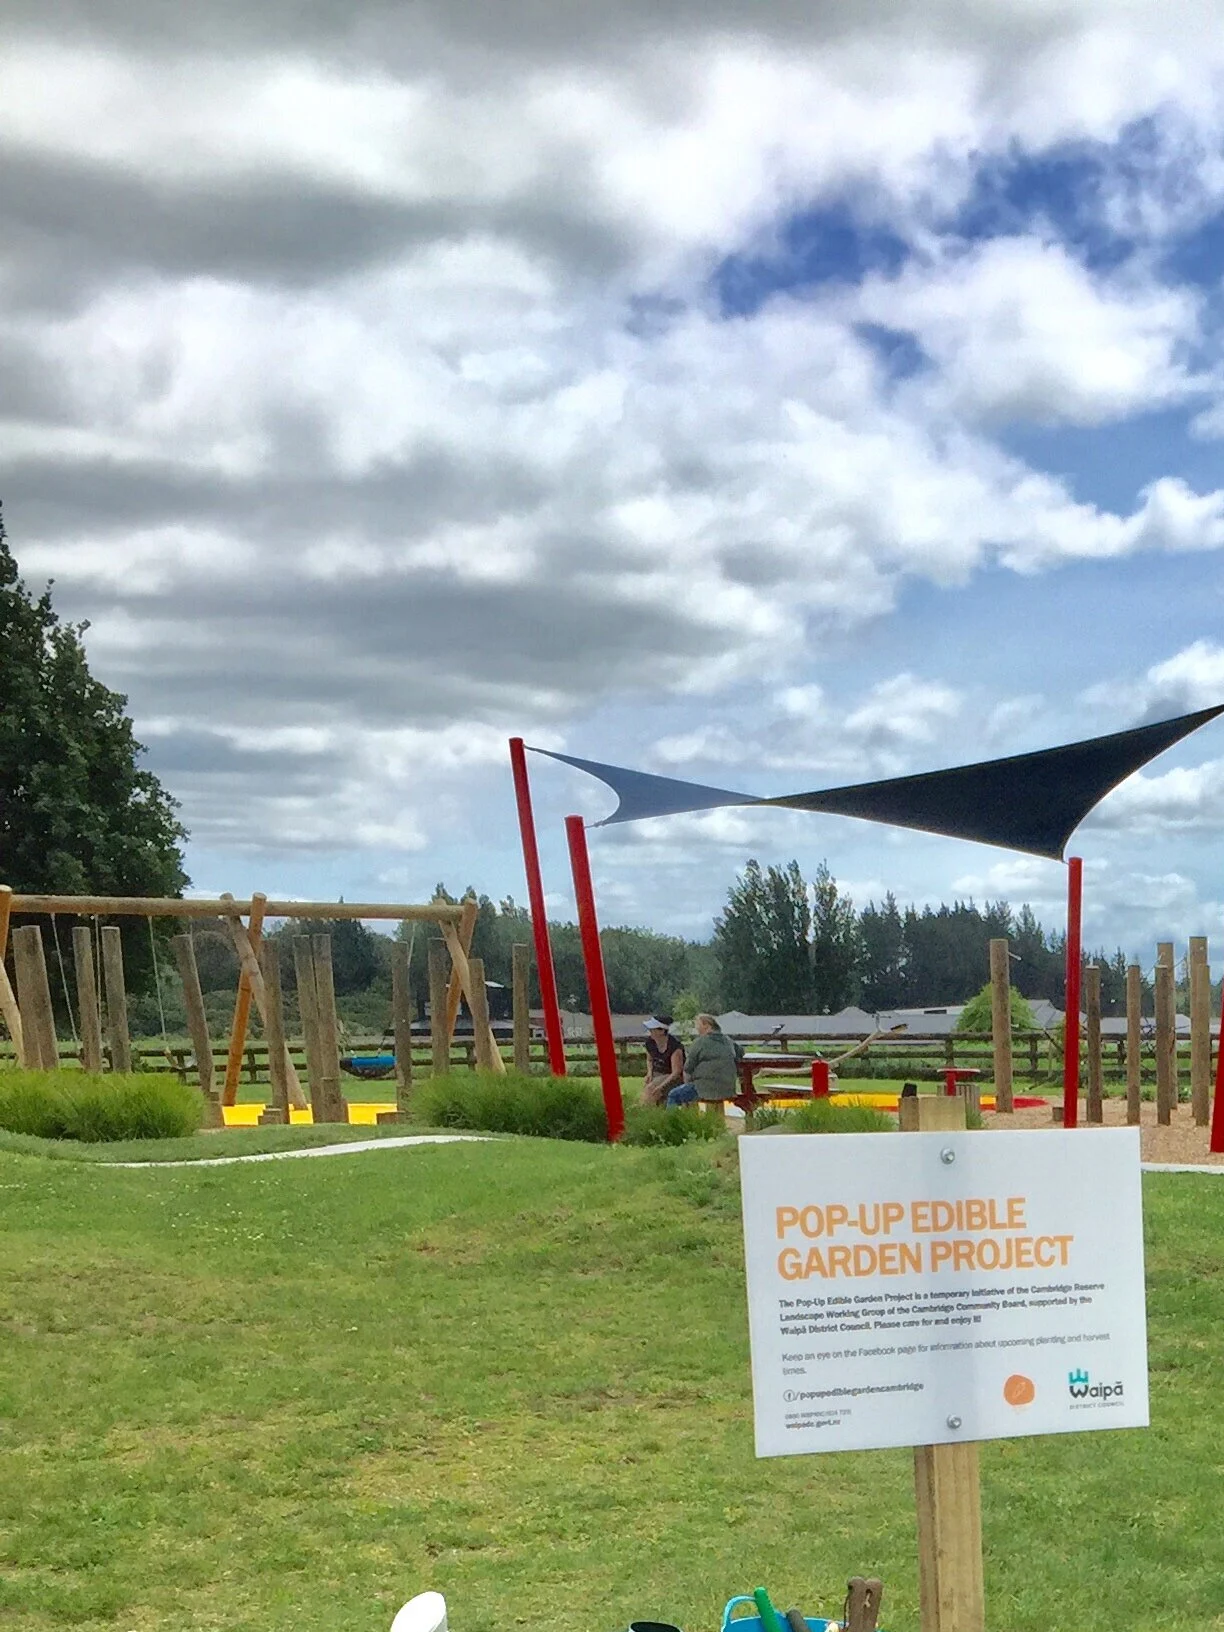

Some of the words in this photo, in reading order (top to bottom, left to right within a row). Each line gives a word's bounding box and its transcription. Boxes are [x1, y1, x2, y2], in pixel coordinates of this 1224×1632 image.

[775, 1202, 905, 1240] POP-UP
[910, 1197, 1027, 1233] EDIBLE
[777, 1242, 923, 1281] GARDEN
[930, 1234, 1074, 1273] PROJECT
[779, 1299, 795, 1308] The
[796, 1298, 826, 1308] Pop-Up
[827, 1296, 852, 1305] Edible
[853, 1295, 883, 1304] Garden
[884, 1292, 913, 1302] Project
[914, 1292, 922, 1300] is
[930, 1290, 970, 1301] temporary
[971, 1287, 1005, 1297] initiative
[1006, 1286, 1015, 1295] of
[1016, 1286, 1030, 1295] the
[1030, 1284, 1073, 1294] Cambridge
[1074, 1282, 1106, 1292] Reserve
[780, 1312, 825, 1322] Landscape
[826, 1309, 860, 1319] Working
[861, 1308, 886, 1318] Group
[887, 1307, 895, 1315] of
[896, 1306, 910, 1315] the
[911, 1304, 955, 1314] Cambridge
[955, 1298, 1000, 1311] Community
[1002, 1299, 1028, 1309] Board,
[1029, 1296, 1068, 1308] supported
[1068, 1296, 1078, 1306] by
[1079, 1296, 1093, 1304] the
[808, 1323, 838, 1334] District
[873, 1320, 901, 1330] Please
[902, 1319, 920, 1328] care
[921, 1317, 933, 1327] for
[934, 1316, 949, 1326] and
[950, 1315, 972, 1326] enjoy
[782, 1352, 804, 1362] Keep
[804, 1352, 816, 1361] an
[816, 1351, 831, 1361] eye
[832, 1350, 843, 1359] on
[843, 1349, 857, 1358] the
[858, 1346, 896, 1357] Facebook
[897, 1345, 917, 1356] page
[917, 1343, 928, 1353] for
[930, 1341, 973, 1352] information
[974, 1340, 997, 1349] about
[998, 1337, 1035, 1348] upcoming
[1036, 1335, 1066, 1346] planting
[1067, 1333, 1082, 1343] and
[1082, 1332, 1111, 1342] harvest
